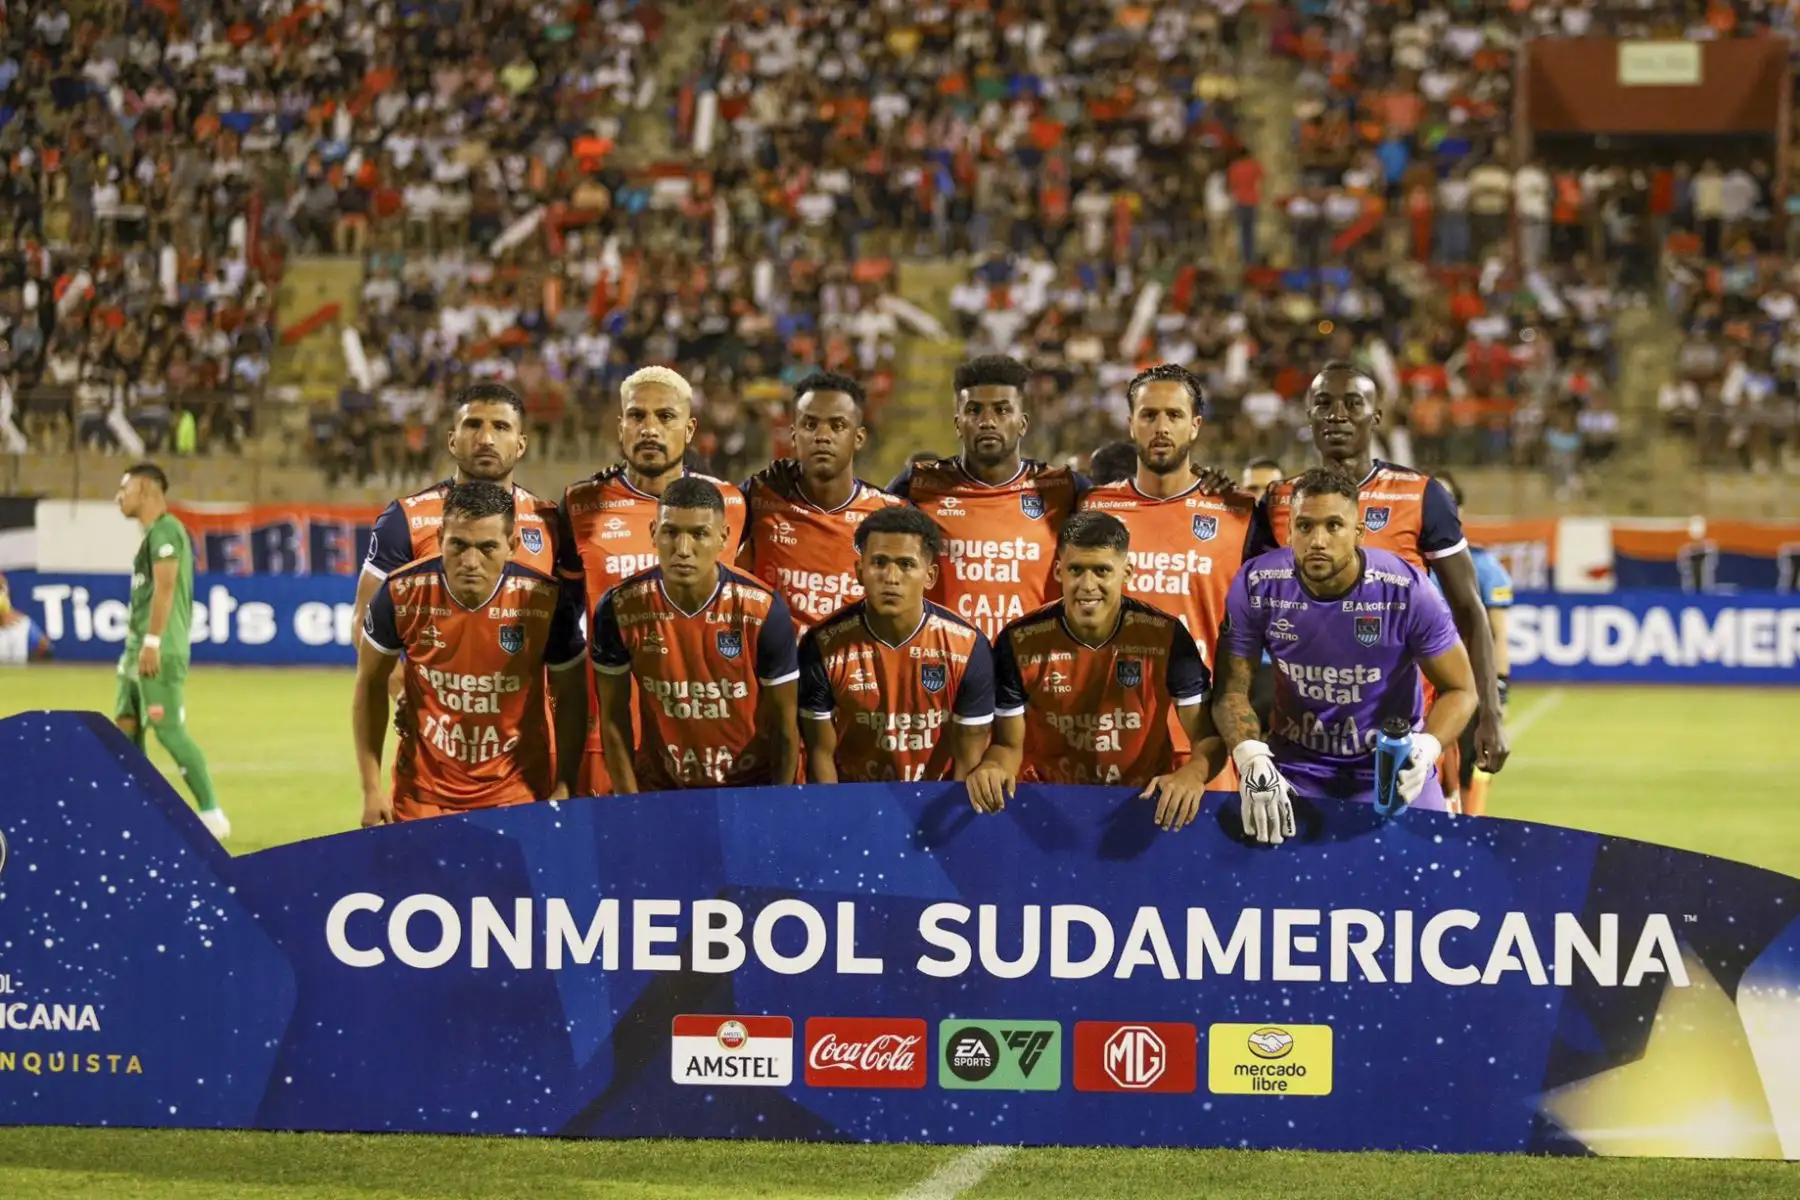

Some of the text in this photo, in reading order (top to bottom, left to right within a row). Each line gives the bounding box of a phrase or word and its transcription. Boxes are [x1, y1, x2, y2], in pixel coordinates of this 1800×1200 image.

[940, 536, 1041, 564] apuesta
[1127, 550, 1212, 575] puesta
[956, 558, 1021, 583] total
[33, 583, 278, 646] Ticets
[790, 591, 842, 614] otal
[958, 593, 1024, 618] CAJA
[418, 663, 520, 693] apuesta
[1277, 658, 1382, 684] apuesta
[437, 688, 501, 714] total
[643, 675, 748, 703] apuesta
[1297, 681, 1362, 705] total
[662, 698, 730, 719] total
[325, 892, 884, 974] CONMEBOL
[916, 903, 1691, 988] SUDAMERICANA
[810, 1033, 921, 1071] Coca-Cola
[956, 1039, 990, 1056] EA
[1110, 1032, 1160, 1082] MG
[0, 1052, 143, 1075] NQUISTA
[686, 1056, 778, 1078] AMSTEL
[954, 1057, 991, 1068] SPORTS
[1234, 1062, 1307, 1077] mercado
[1252, 1076, 1288, 1092] libre
